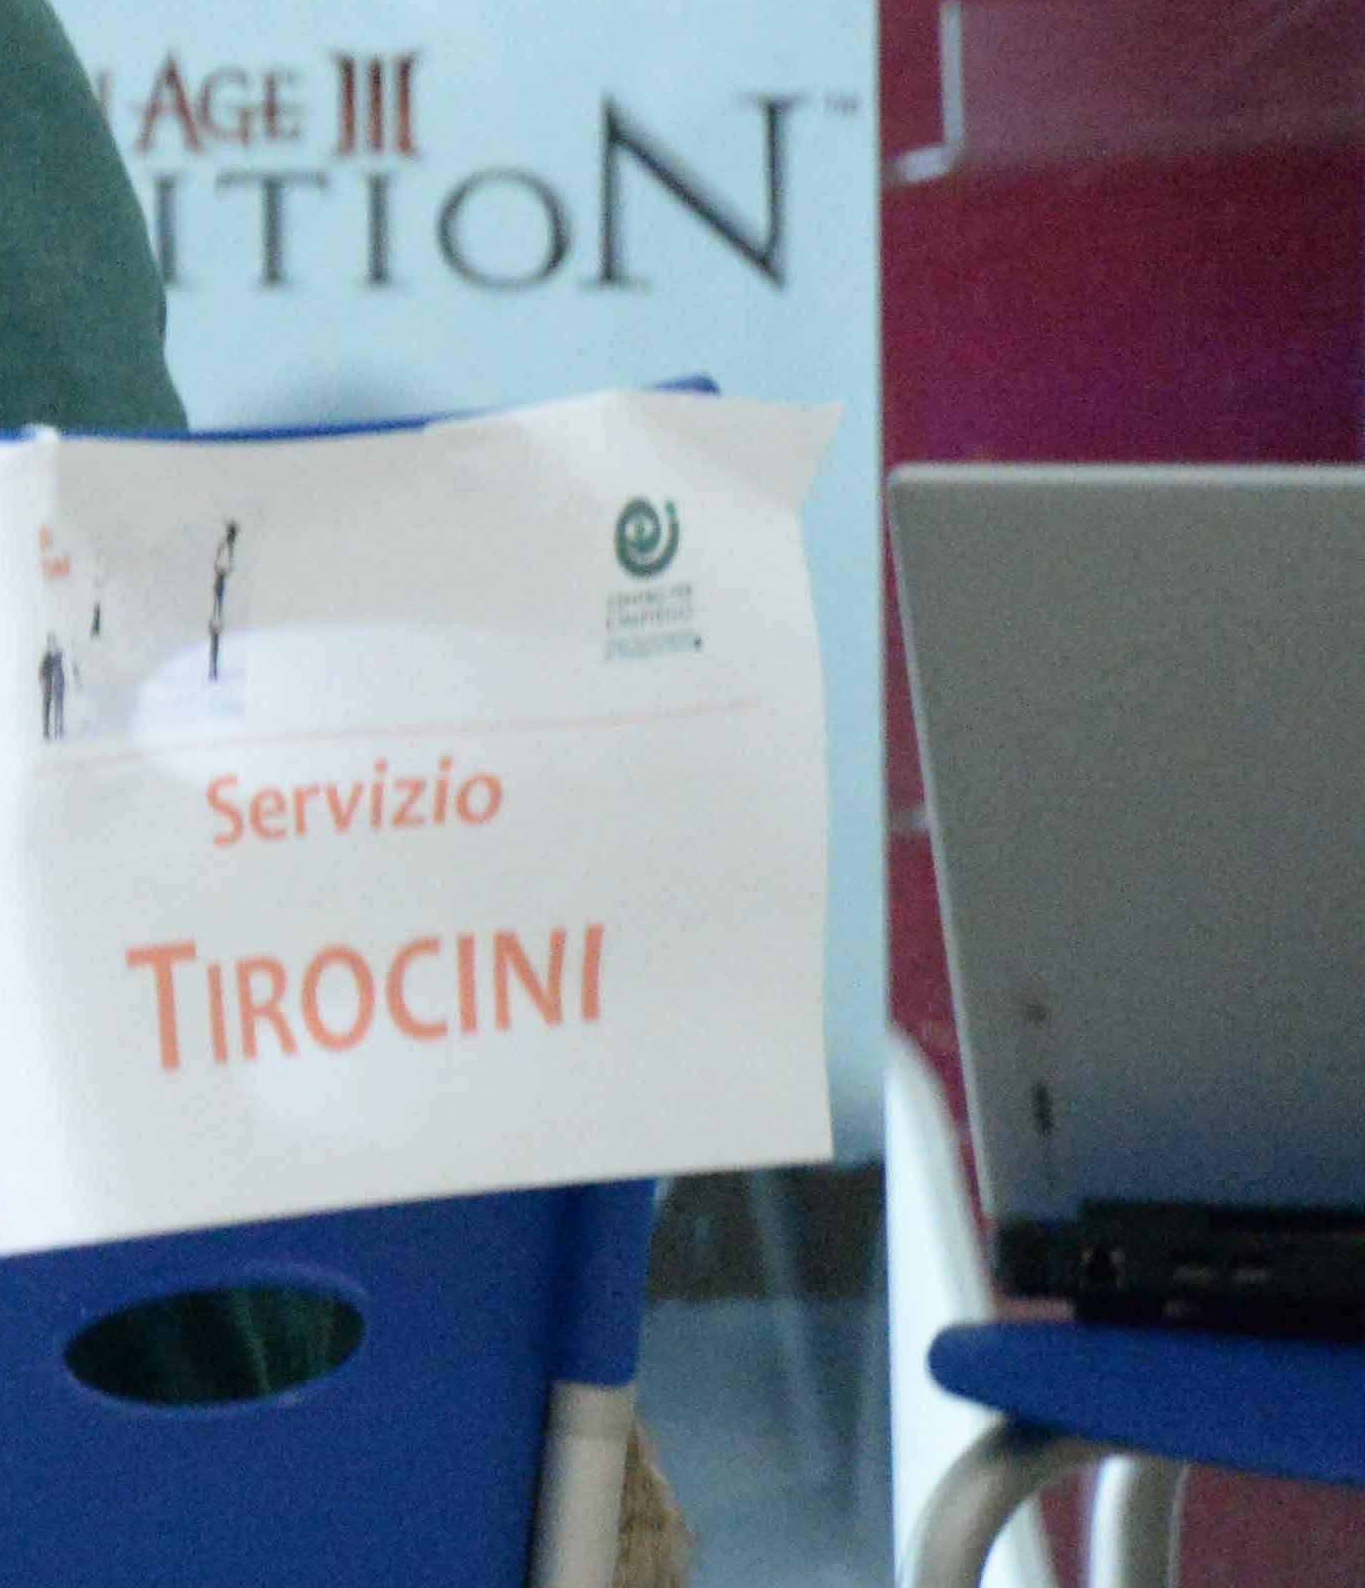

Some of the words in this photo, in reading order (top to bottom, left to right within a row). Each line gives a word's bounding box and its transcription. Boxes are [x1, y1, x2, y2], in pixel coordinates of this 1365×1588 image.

[135, 49, 303, 154] AGE
[329, 48, 423, 160] III
[205, 755, 504, 849] Servizio
[125, 922, 605, 1074] TIROCINI
